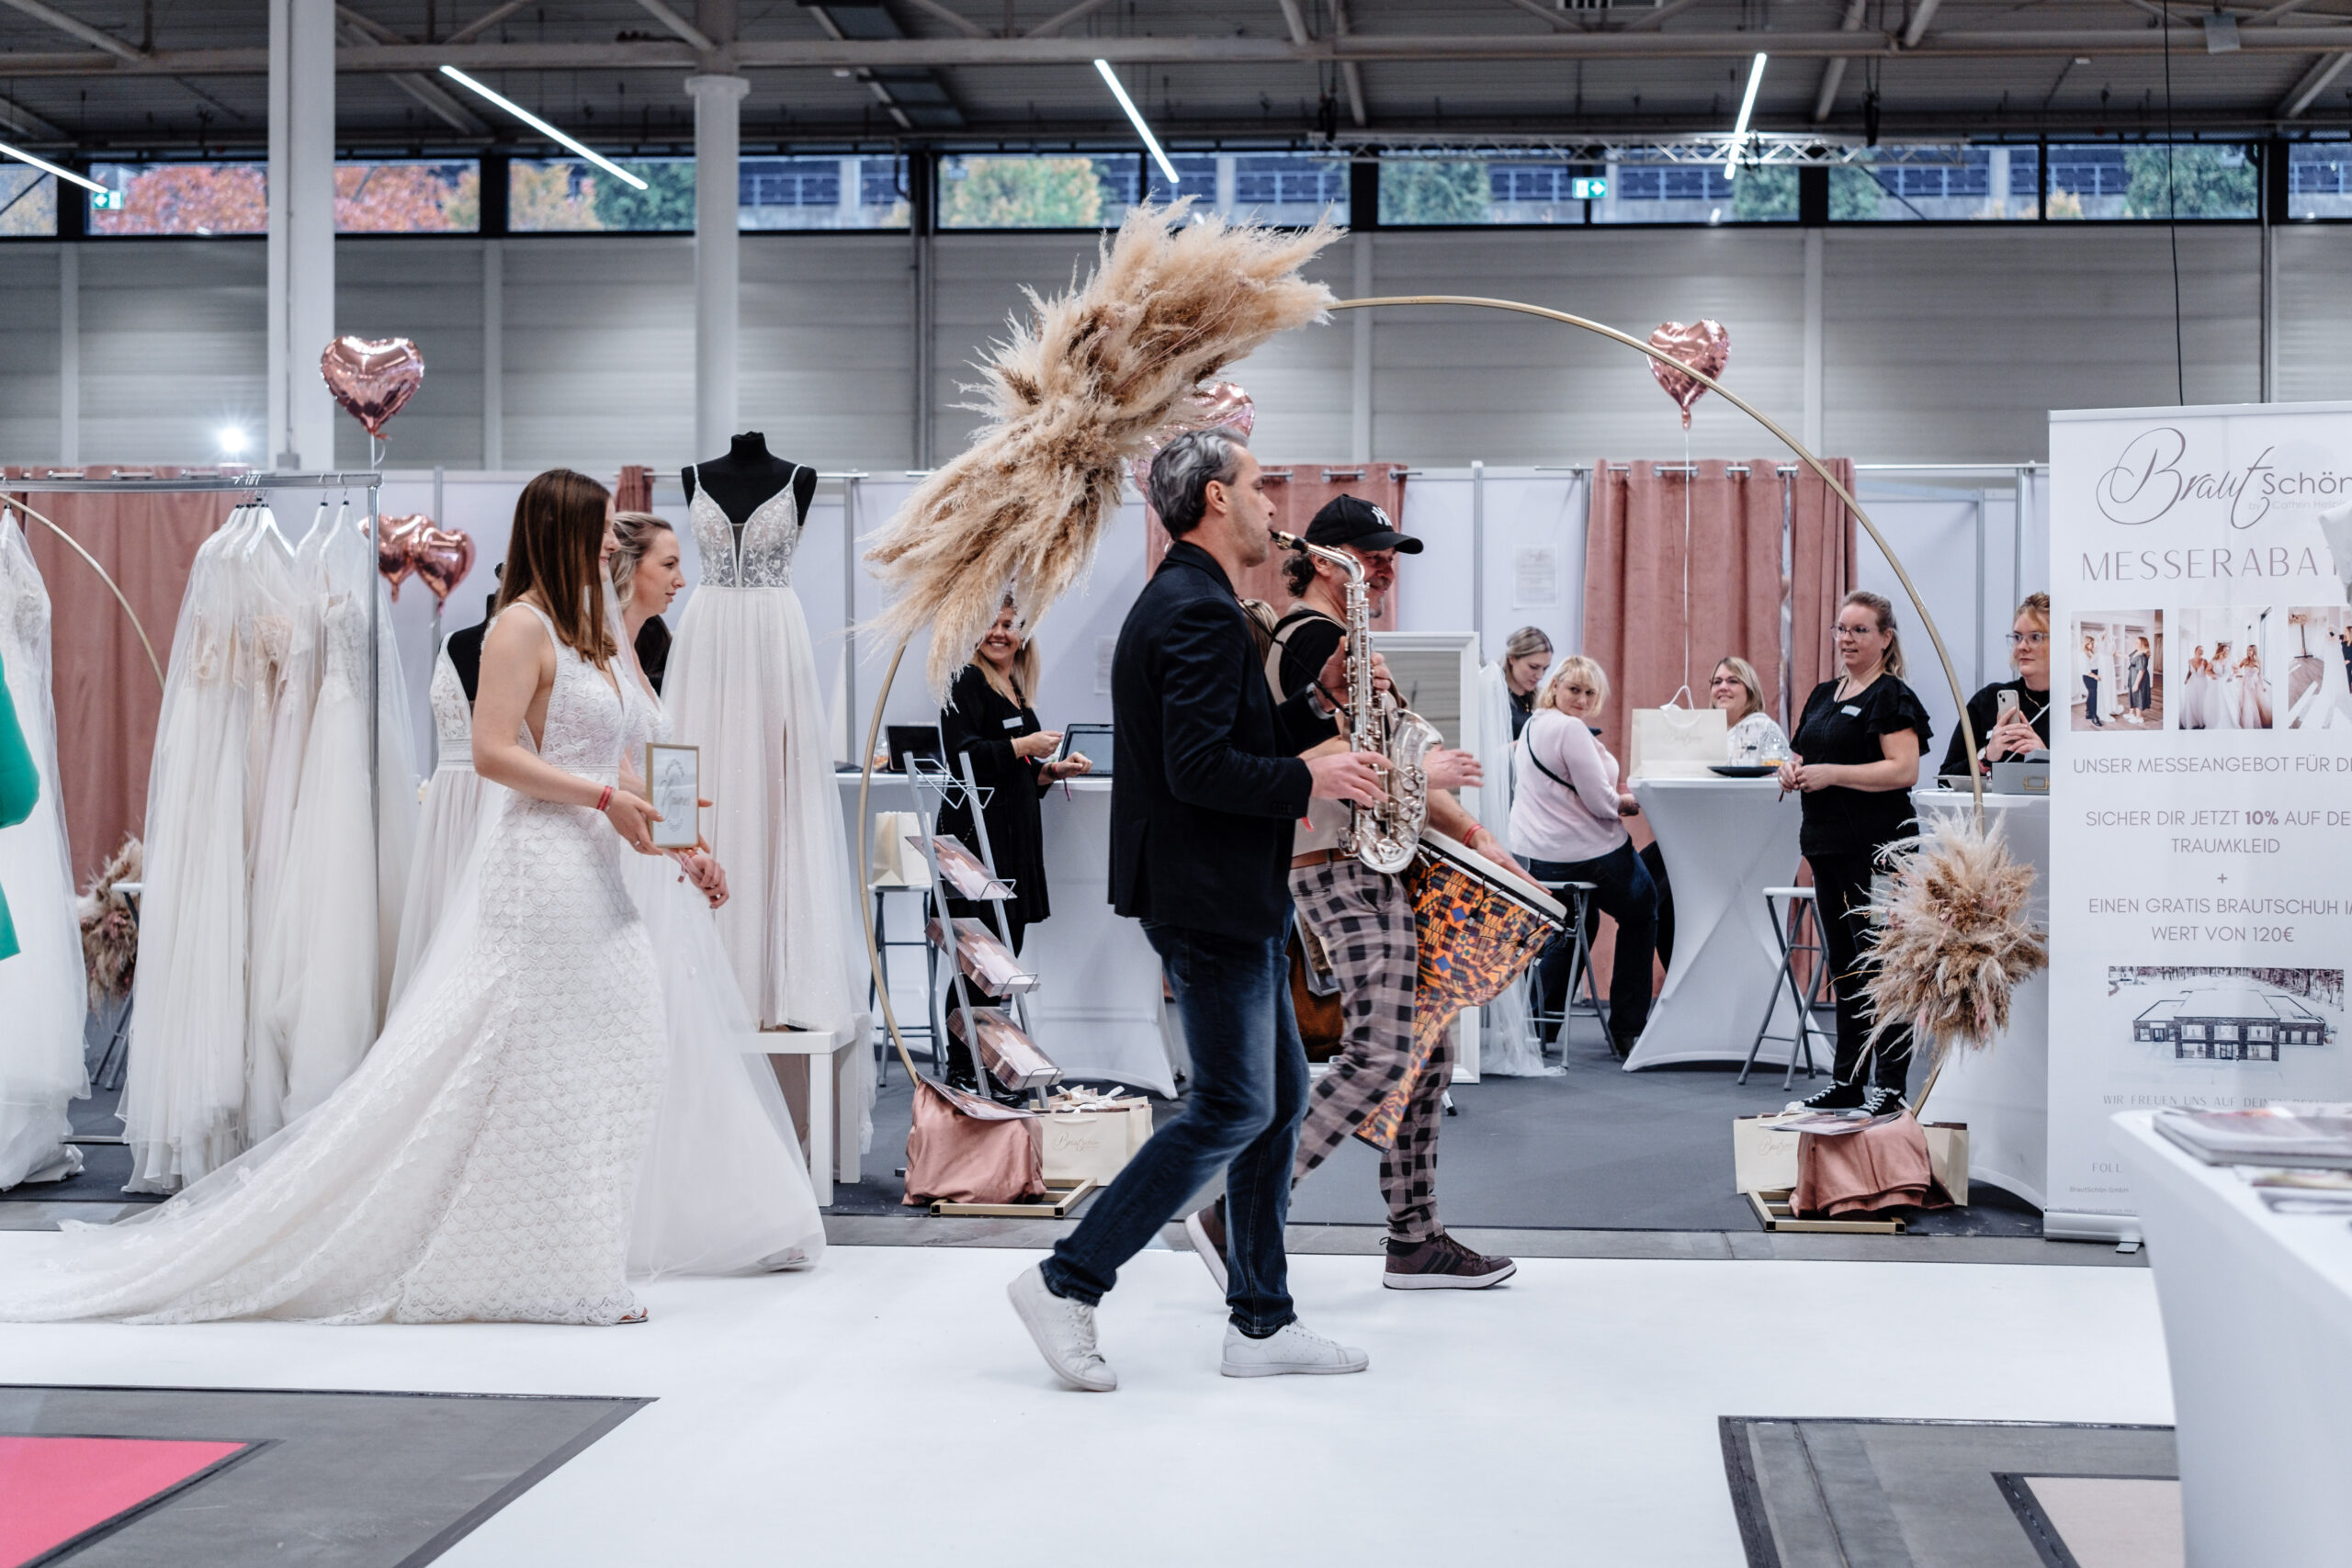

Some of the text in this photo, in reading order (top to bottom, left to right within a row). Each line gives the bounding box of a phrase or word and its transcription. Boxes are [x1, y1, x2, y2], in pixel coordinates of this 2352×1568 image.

[2073, 753, 2352, 773] UNSER MESSEANGEBOT FÜR D
[2086, 810, 2151, 827] SICHER
[2156, 810, 2185, 826] DIR
[2190, 810, 2240, 826] JETZT
[2245, 810, 2279, 826] 10%
[2284, 810, 2321, 826] AUF
[2171, 838, 2280, 853] TRAUMKLEID
[2088, 898, 2139, 913] EINEN
[2145, 898, 2211, 913] GRATIS
[2217, 898, 2338, 915] BRAUTSCHUH
[2152, 926, 2294, 942] WERT VON 120€
[2103, 1094, 2124, 1105] WIR
[2131, 1094, 2177, 1106] FREUEN
[2184, 1095, 2206, 1106] UNS
[2214, 1096, 2235, 1108] AUF
